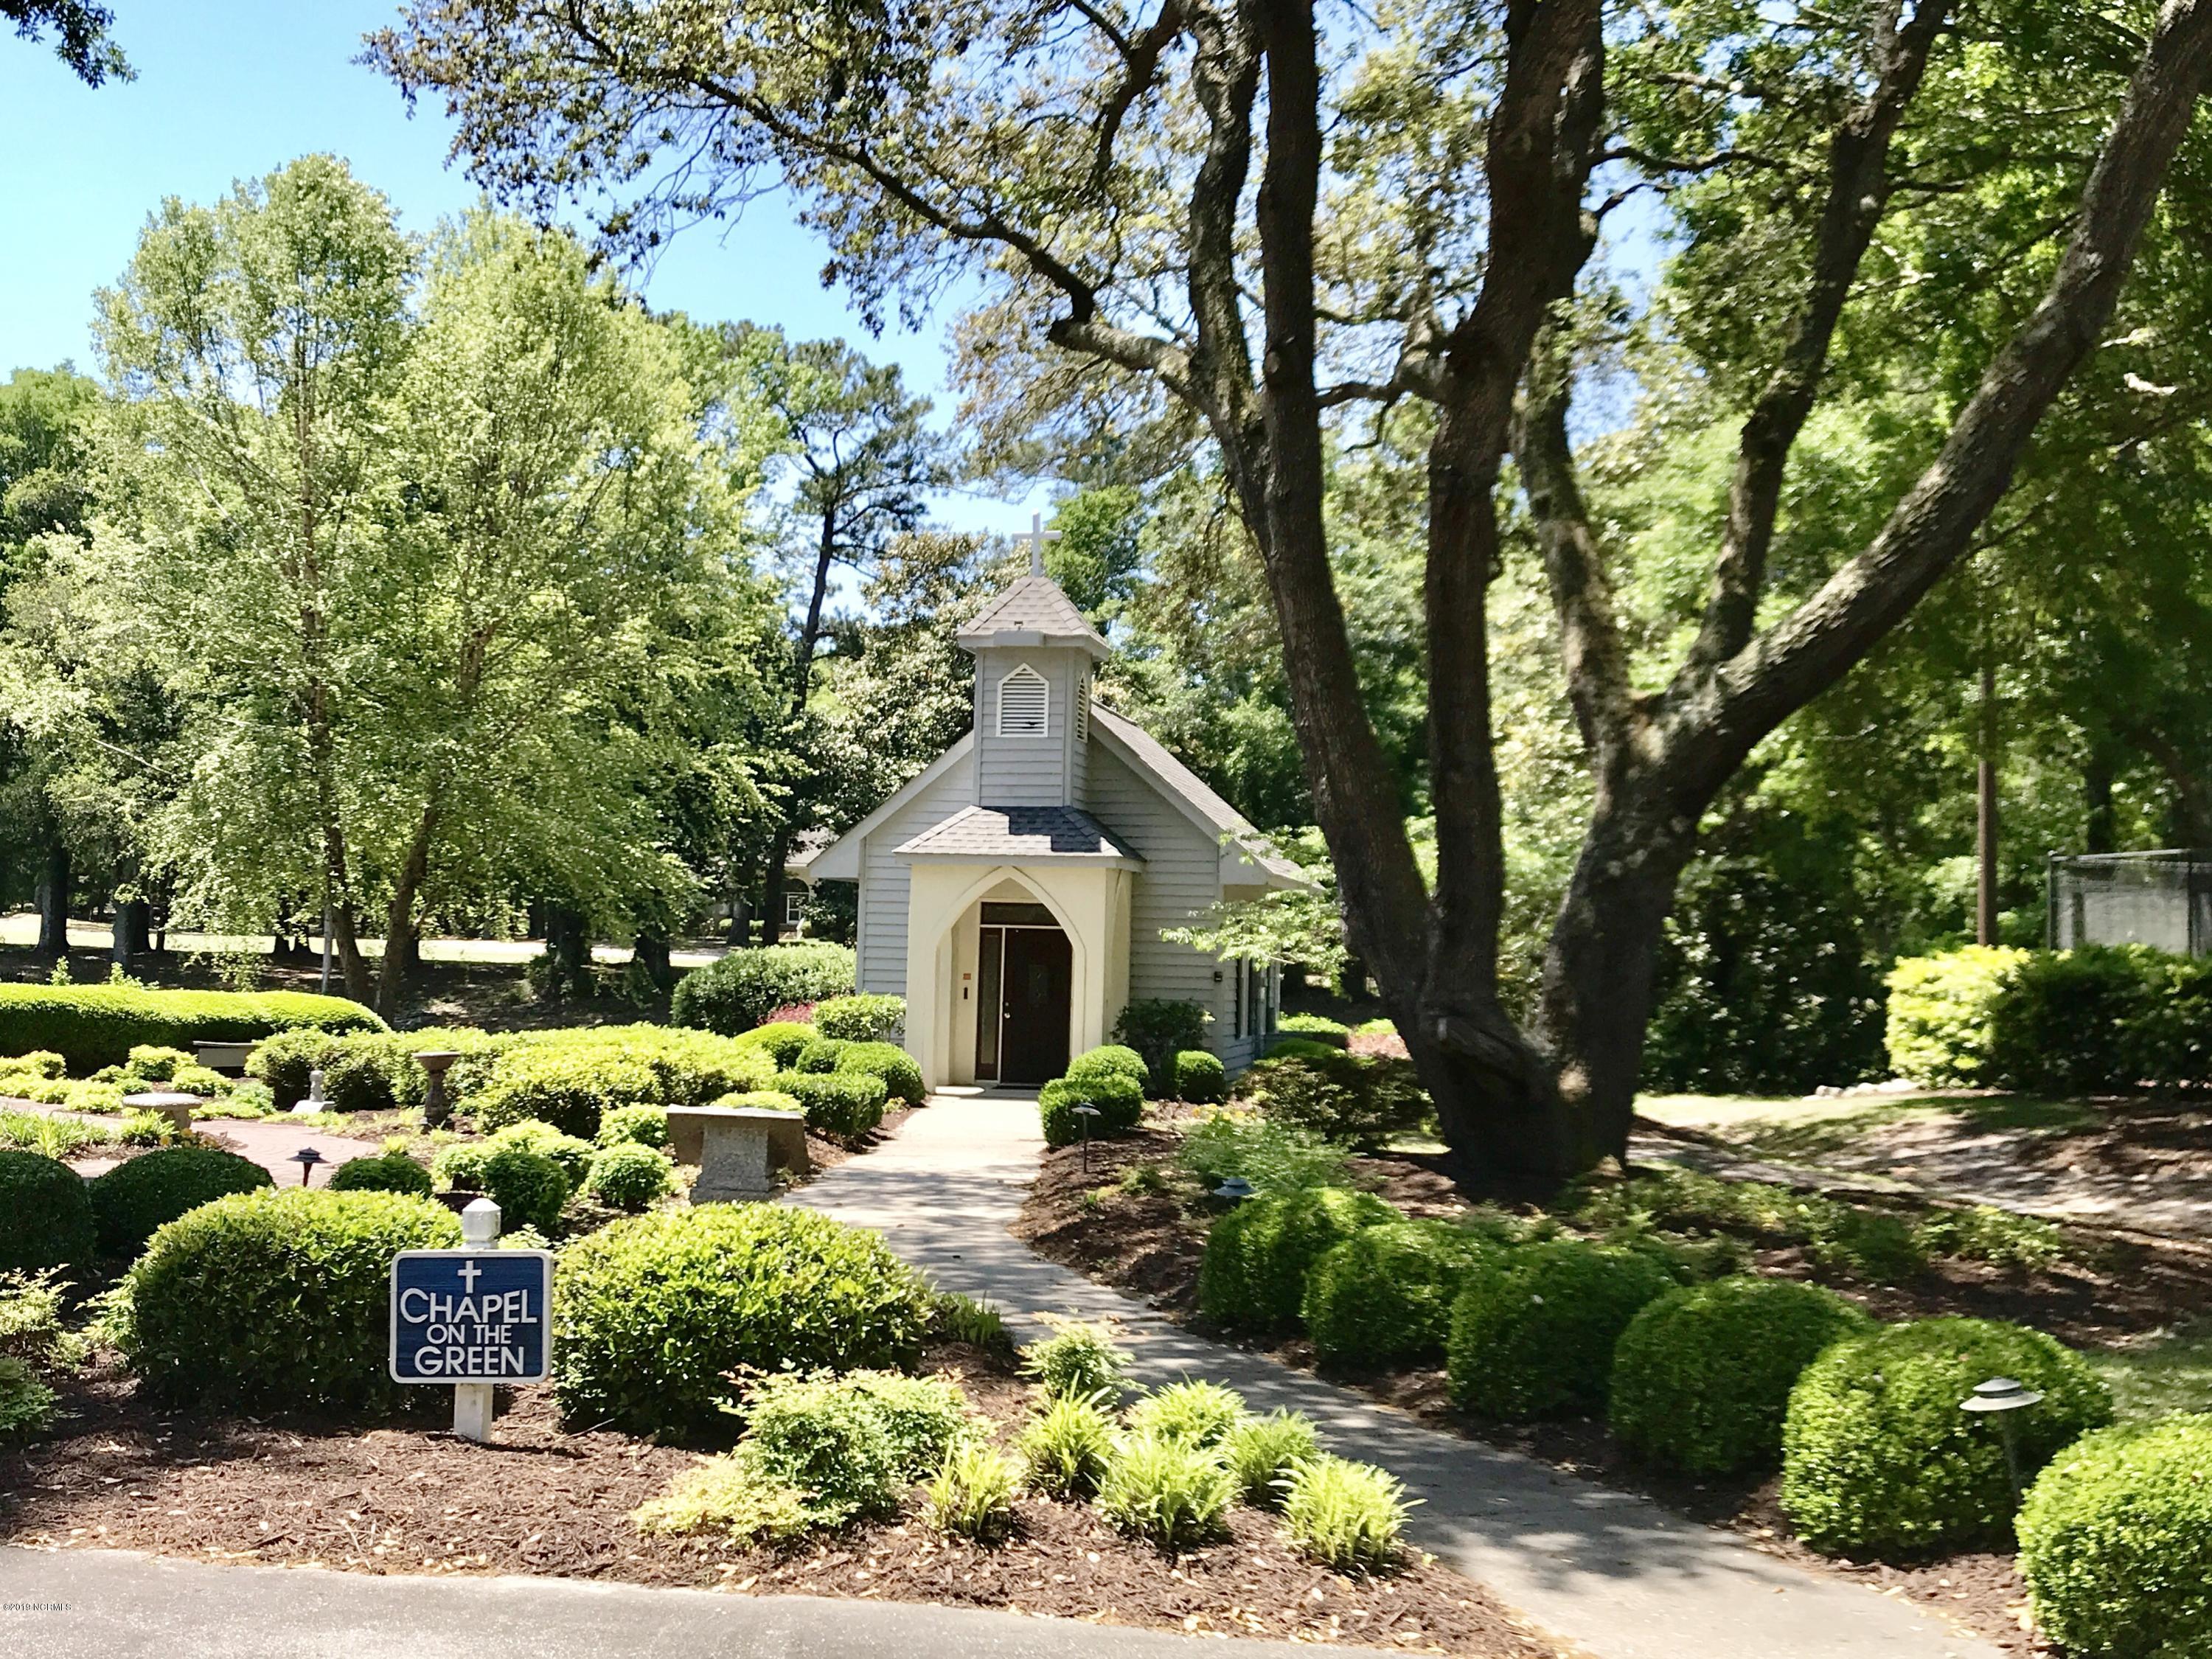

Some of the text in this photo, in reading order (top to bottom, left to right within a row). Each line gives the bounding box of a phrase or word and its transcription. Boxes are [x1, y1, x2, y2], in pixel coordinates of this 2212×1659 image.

[400, 1287, 538, 1324] CHAPEL
[426, 1324, 512, 1344] ON THE
[414, 1346, 524, 1375] GREEN
